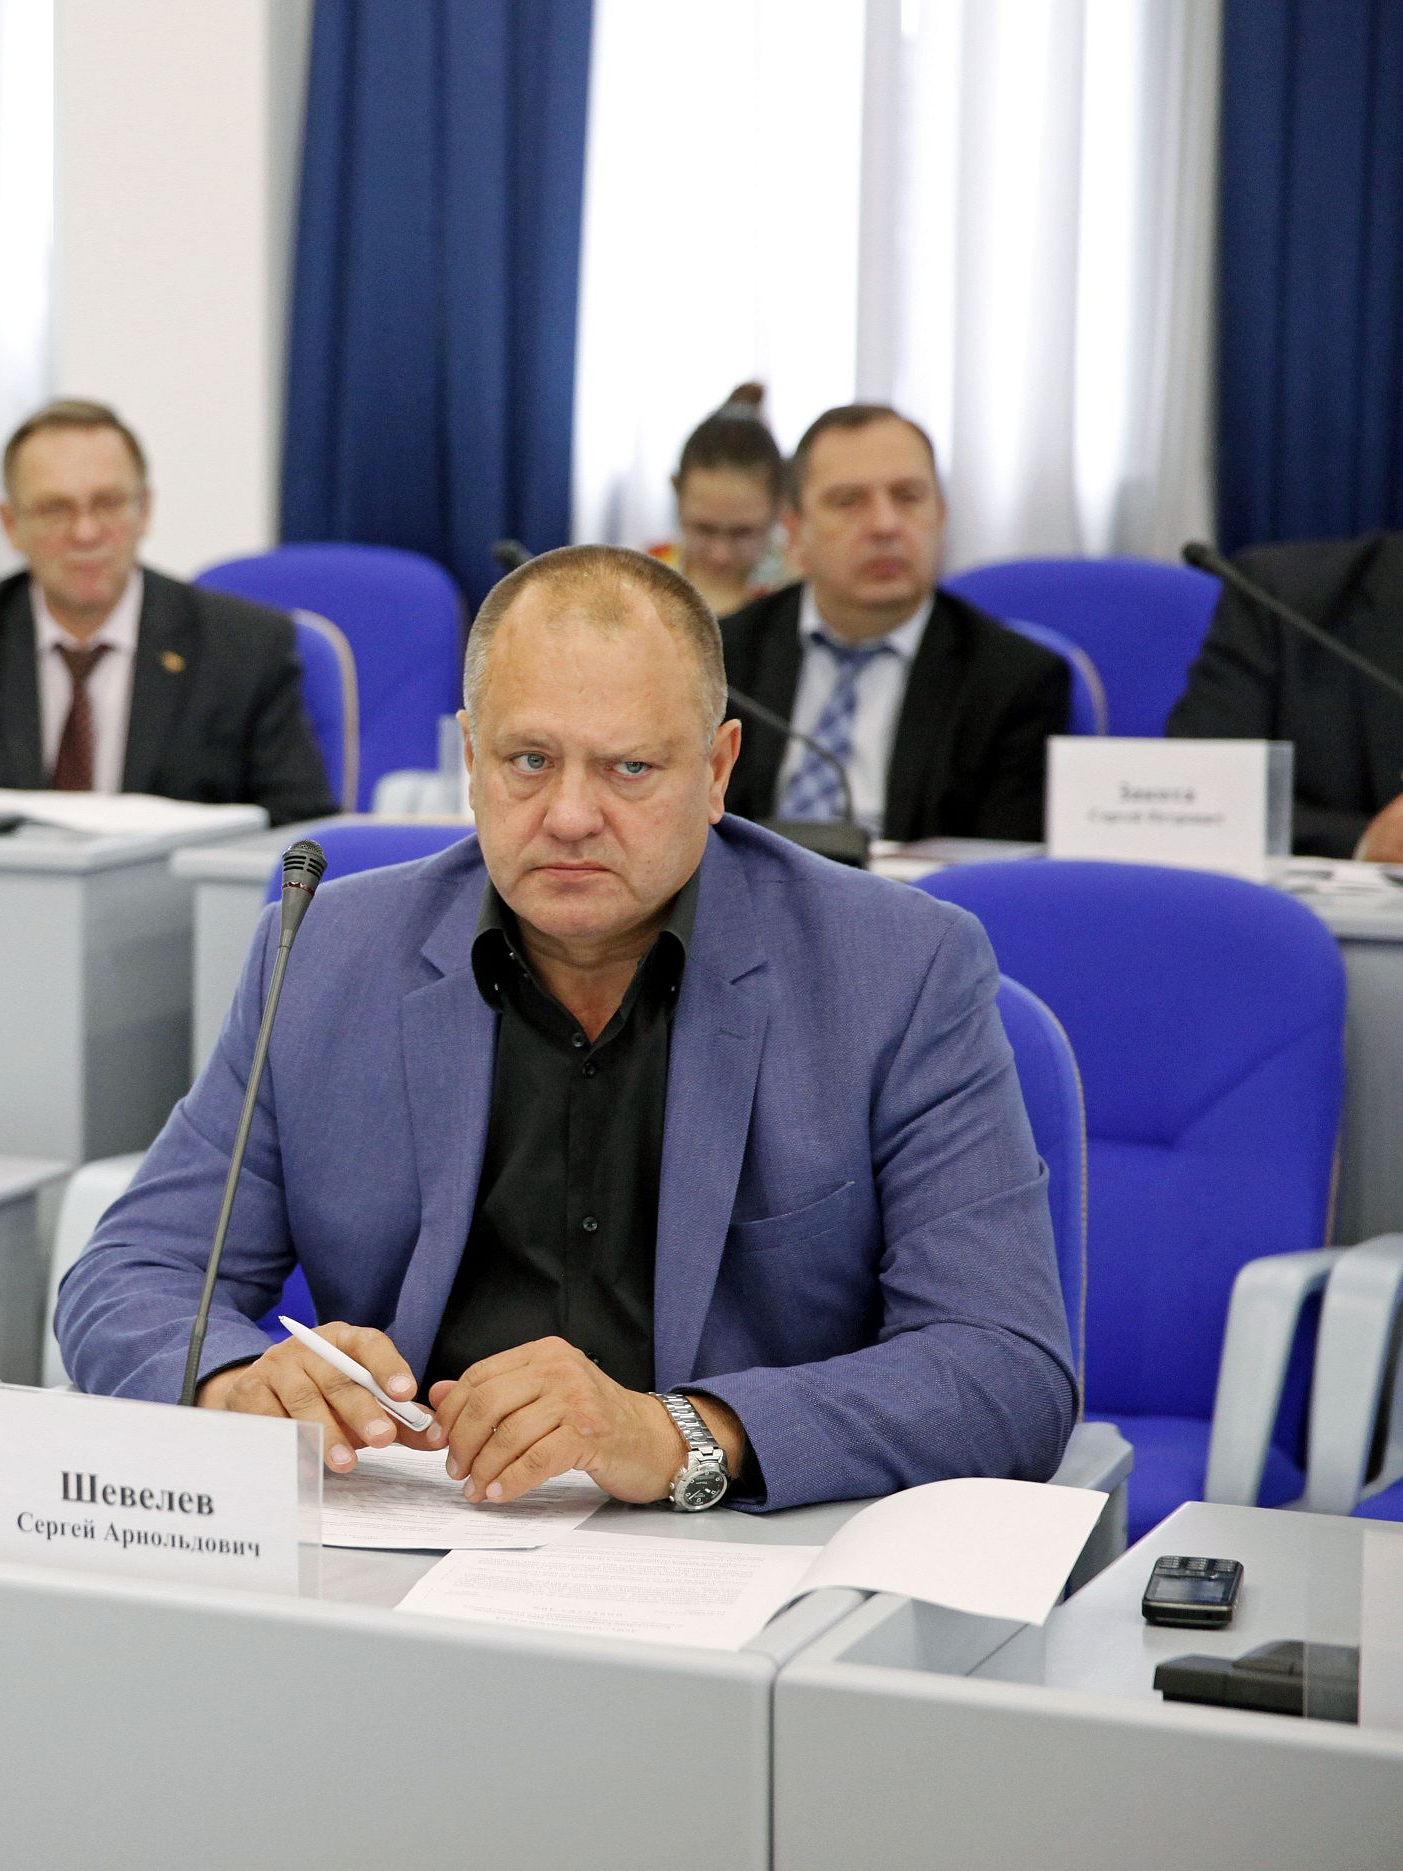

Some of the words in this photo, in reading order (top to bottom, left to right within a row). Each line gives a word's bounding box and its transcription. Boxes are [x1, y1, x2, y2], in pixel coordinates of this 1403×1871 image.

[60, 1470, 215, 1516] Шевелев
[16, 1511, 96, 1541] Сергей
[103, 1522, 261, 1559] Арнольдович
